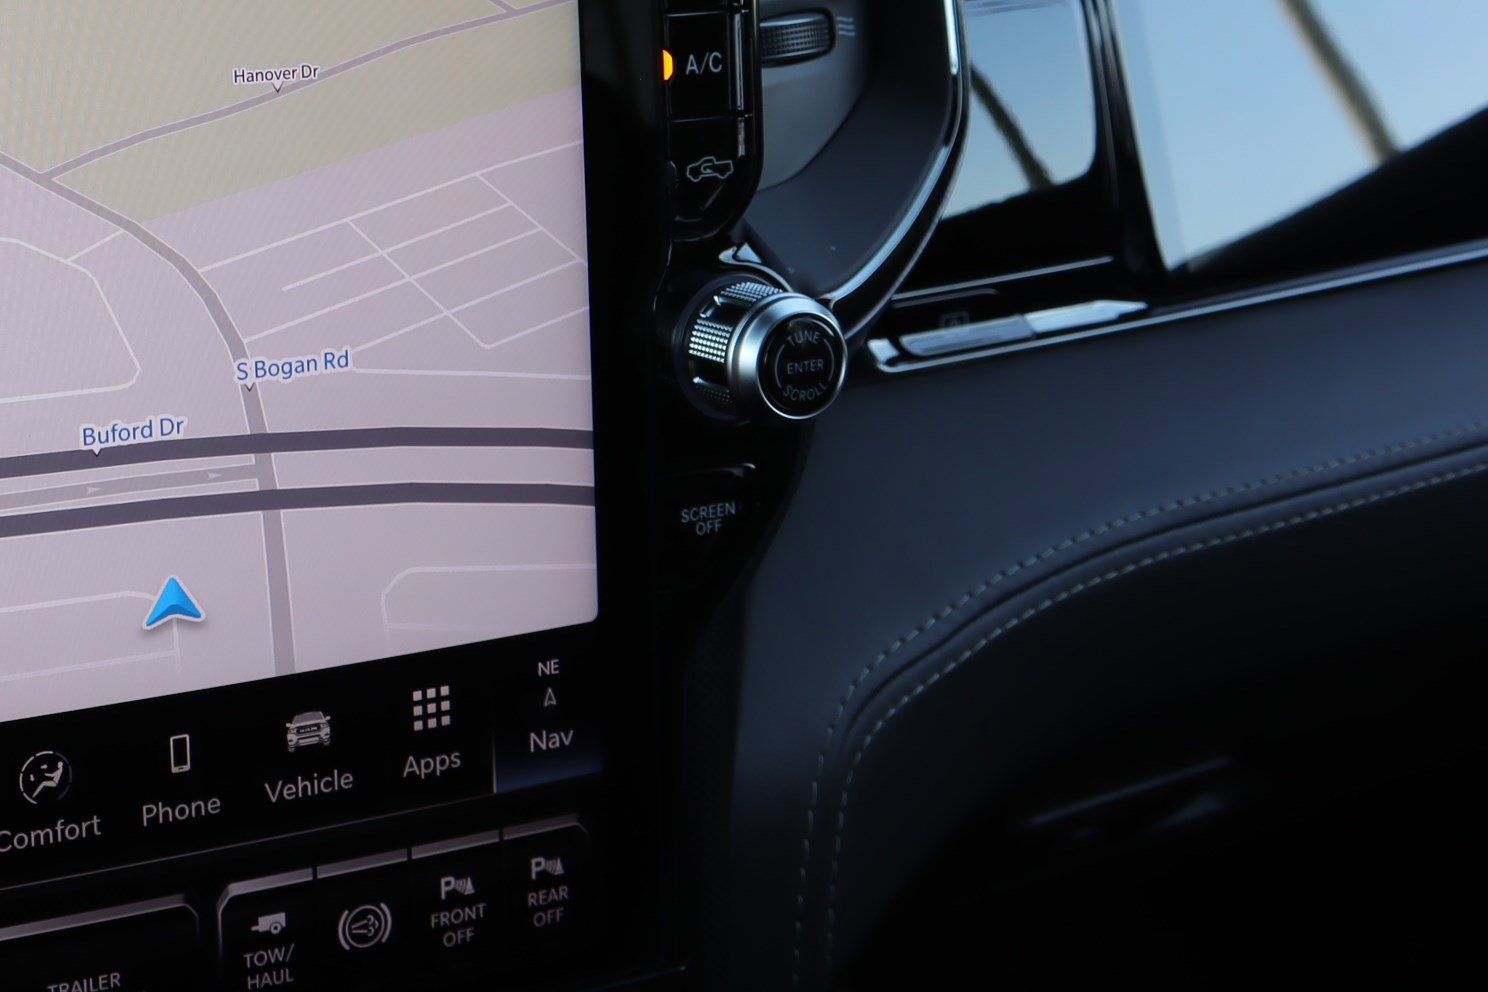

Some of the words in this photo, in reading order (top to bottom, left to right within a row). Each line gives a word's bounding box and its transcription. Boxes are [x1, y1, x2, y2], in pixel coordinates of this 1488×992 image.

[233, 67, 298, 84] Hanover
[300, 64, 319, 80] Dr
[685, 52, 724, 75] A/C
[786, 331, 821, 348] TUNE
[236, 362, 249, 381] S
[253, 356, 318, 380] Bogan
[323, 349, 350, 370] Rd
[786, 359, 825, 375] ENTER
[782, 380, 828, 402] SCROLL
[82, 419, 154, 446] Buford
[159, 417, 185, 437] Dr
[680, 501, 737, 524] SCREEN
[695, 519, 723, 536] OFF
[537, 659, 560, 676] NE
[529, 729, 574, 753] Nav
[403, 750, 462, 780] Apps
[264, 769, 354, 803] Vehicle
[141, 796, 222, 828] Phone
[527, 886, 570, 910] REAR
[430, 903, 487, 930] FRONT
[533, 908, 565, 929] OFF
[443, 928, 475, 949] OFF
[243, 944, 295, 970] TOW/
[247, 968, 295, 991] HAUL
